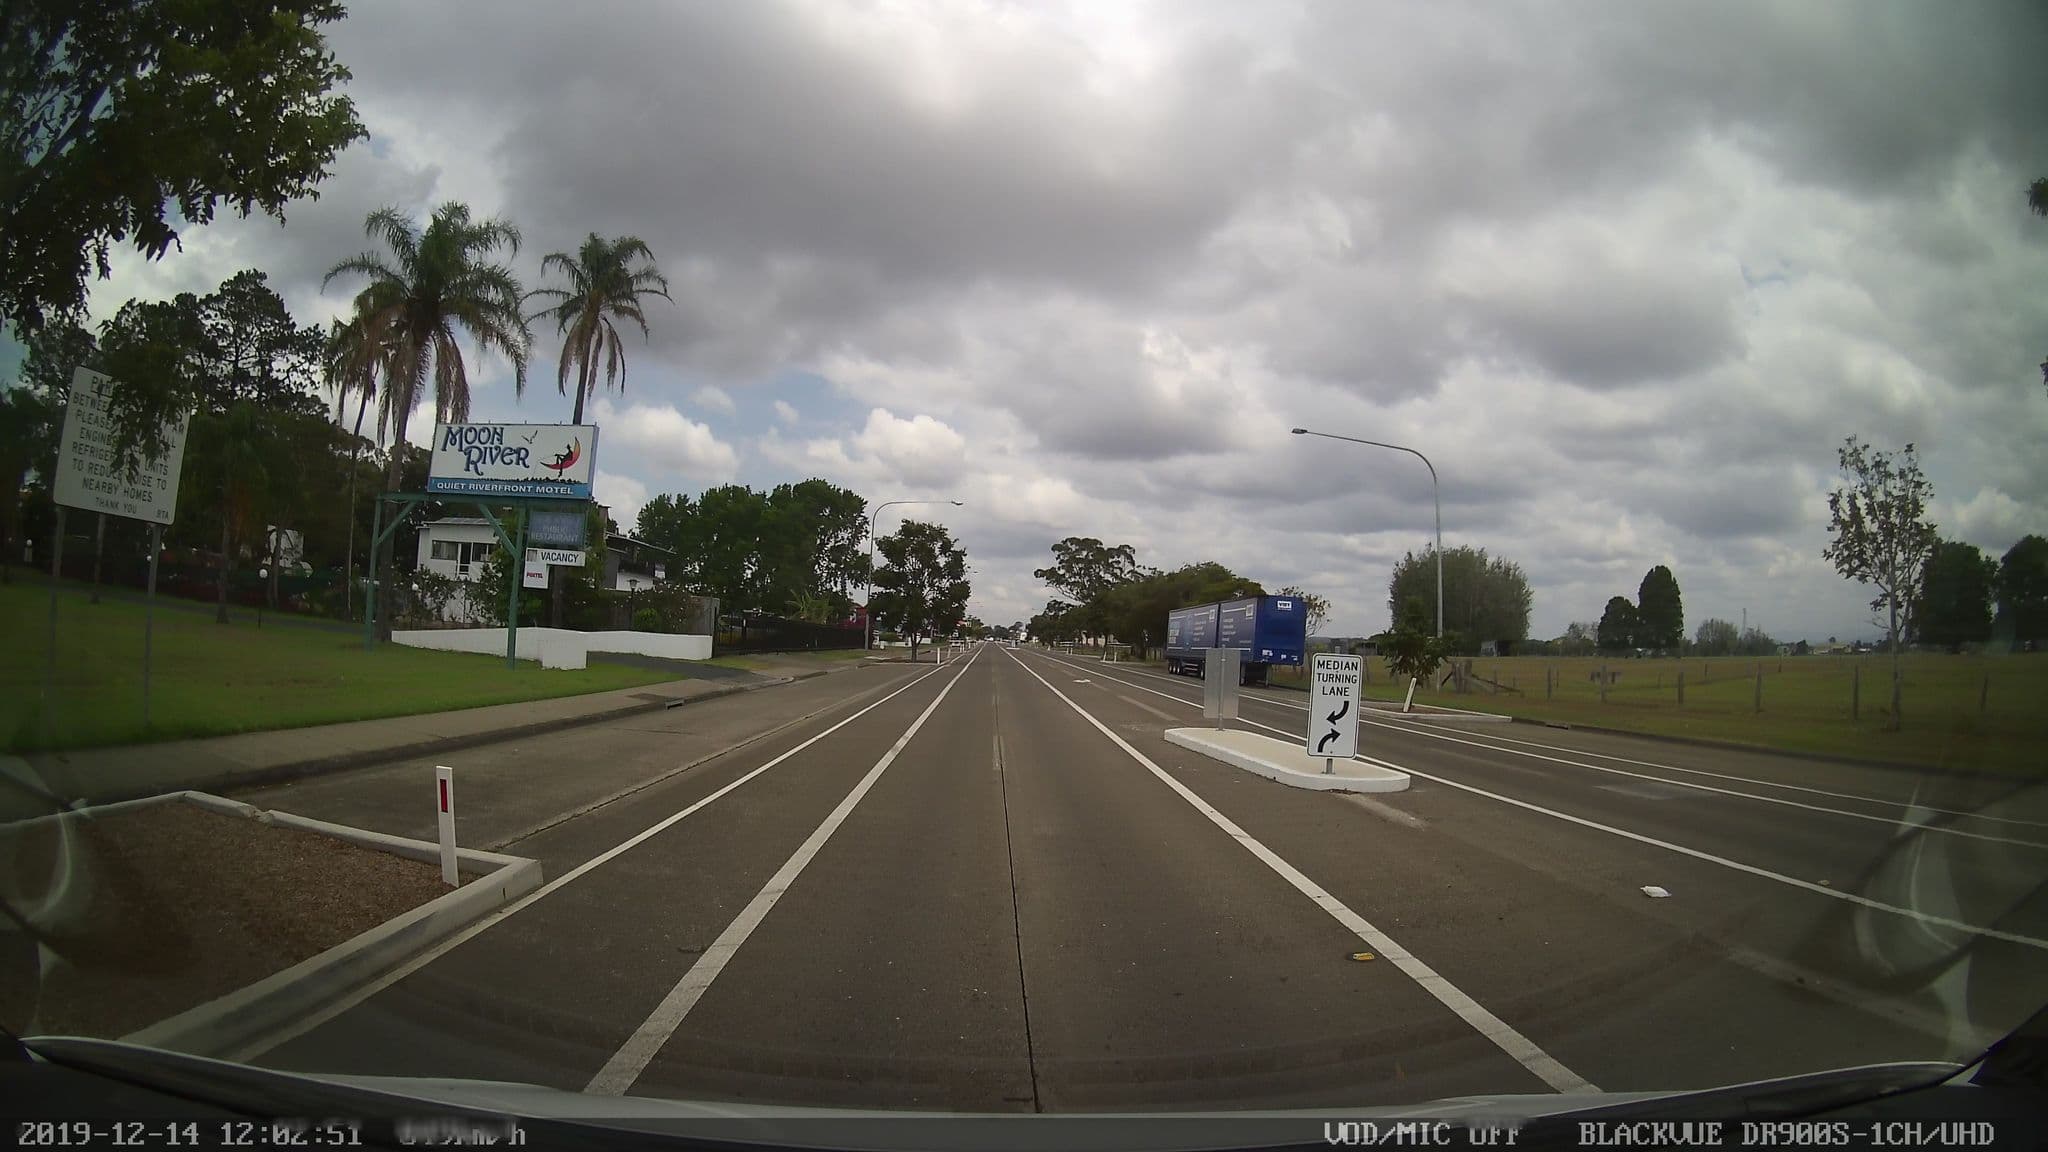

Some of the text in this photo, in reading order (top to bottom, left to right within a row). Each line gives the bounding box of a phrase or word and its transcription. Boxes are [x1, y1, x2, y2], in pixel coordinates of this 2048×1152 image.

[441, 426, 504, 452] MOON
[73, 459, 84, 472] TO
[157, 478, 168, 490] TO
[82, 478, 153, 503] NEARBY HOMES
[437, 482, 574, 495] QUIET RIVERFRONT MOTEL
[95, 497, 137, 515] THANK YOU
[541, 552, 579, 563] VACANCY
[1316, 660, 1359, 671] MEDIAN
[1317, 673, 1357, 684] TURNING
[1322, 686, 1350, 696] LANE
